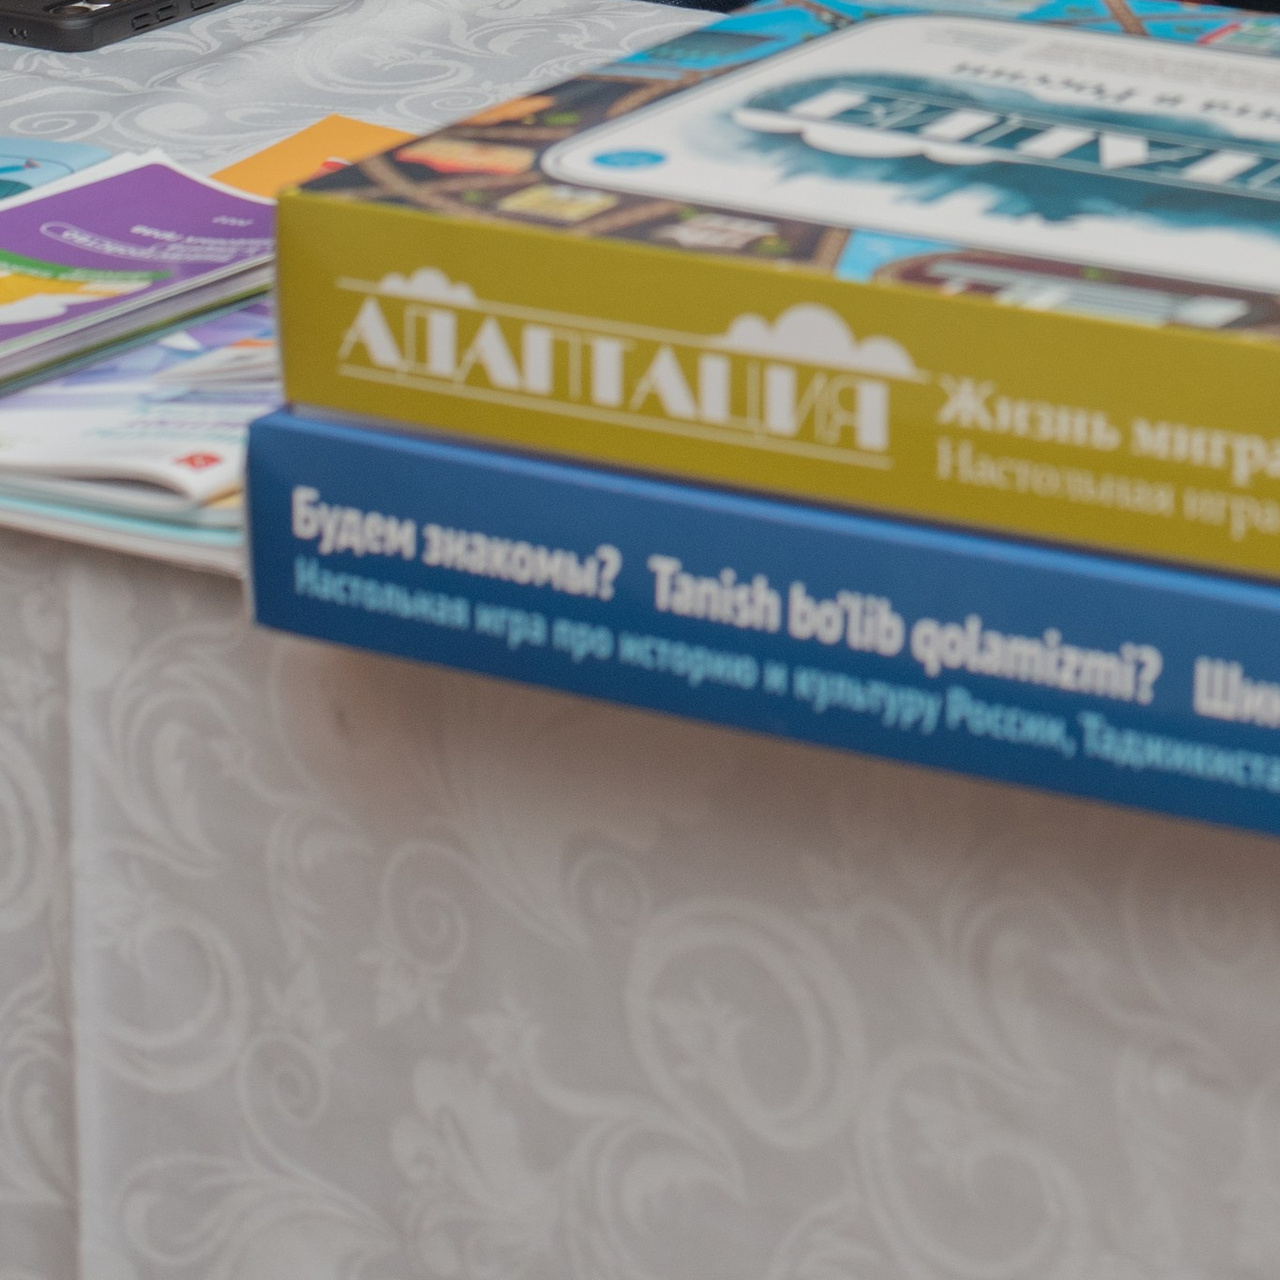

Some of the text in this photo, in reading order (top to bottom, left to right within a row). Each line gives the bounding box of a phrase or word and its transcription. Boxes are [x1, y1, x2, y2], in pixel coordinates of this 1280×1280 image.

[337, 296, 890, 452] АДАПТАЦИЯ
[937, 375, 1122, 449] Жизнь
[936, 439, 1175, 518] Настольная
[291, 489, 416, 559] Будем
[423, 524, 623, 601] знакомы?
[648, 555, 781, 634] Tanish
[911, 614, 1162, 706] qolamizmi?
[295, 558, 470, 630] Настольная
[475, 607, 547, 647] игра
[553, 617, 614, 663] про
[619, 632, 758, 691] историю
[763, 661, 788, 694] и
[793, 667, 942, 733] культуру
[948, 687, 1076, 759] России,
